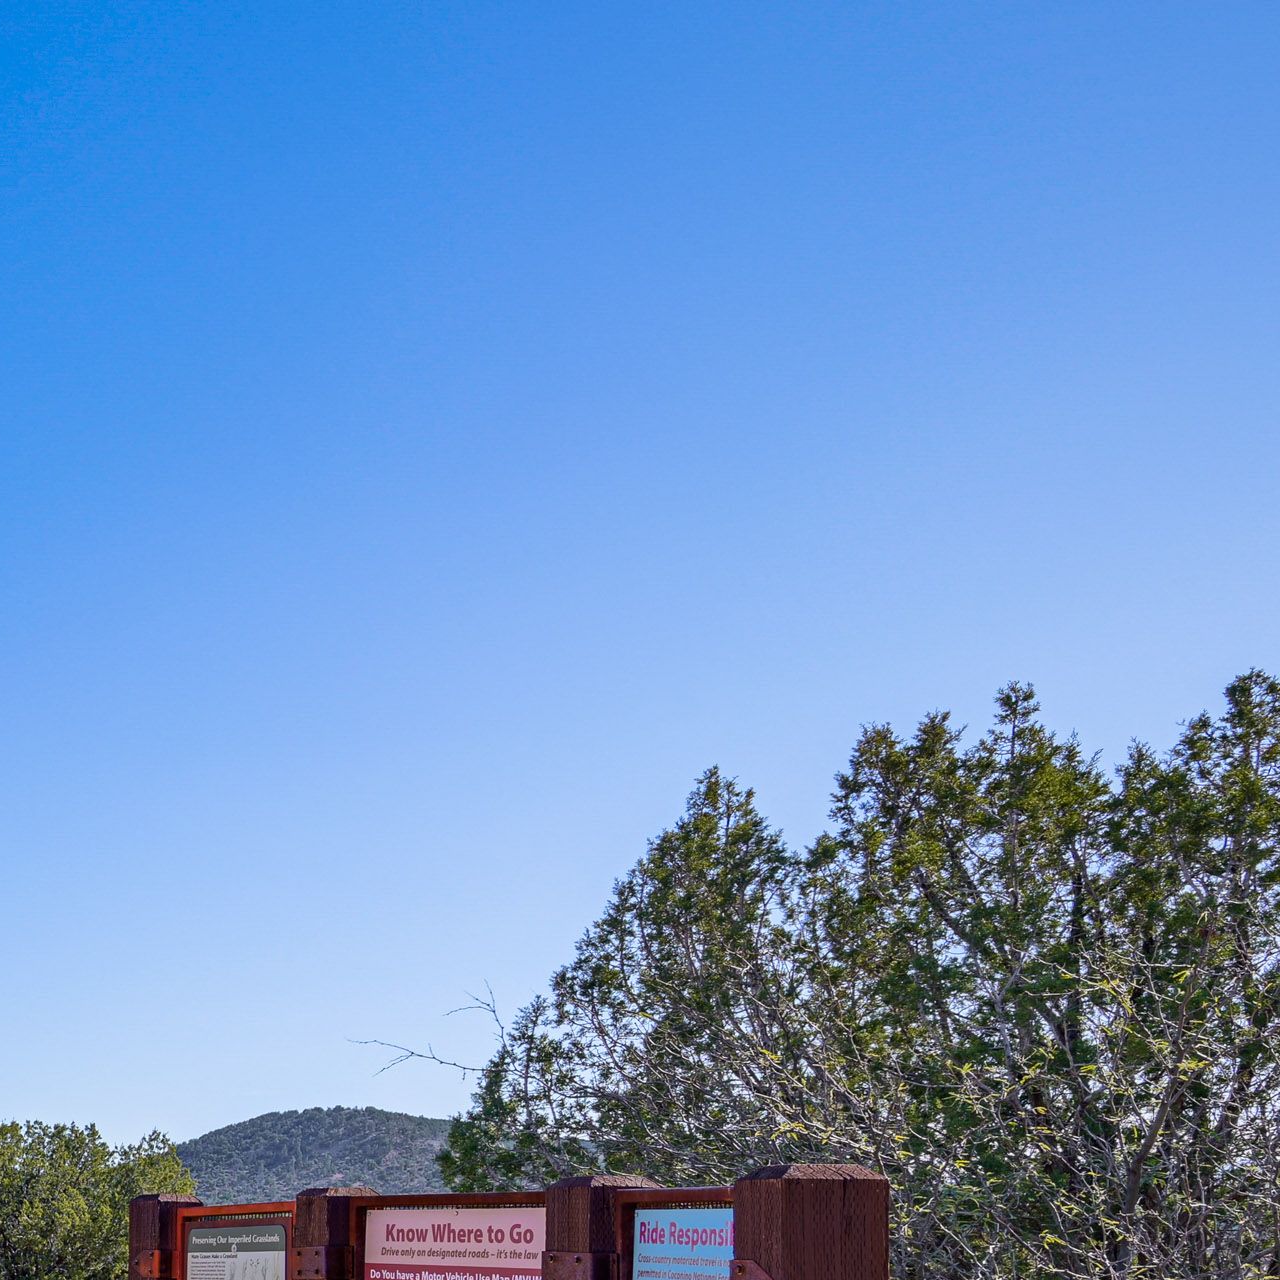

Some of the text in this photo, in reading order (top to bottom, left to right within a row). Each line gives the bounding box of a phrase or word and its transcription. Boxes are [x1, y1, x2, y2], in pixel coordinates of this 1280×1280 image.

[386, 1223, 534, 1244] Know Where to Go
[640, 1221, 665, 1244] Ride
[192, 1234, 280, 1246] Preserving Our Imperiled Grasslands
[381, 1247, 399, 1256] Drive
[400, 1248, 416, 1258] only
[417, 1249, 426, 1257] on
[427, 1248, 467, 1259] designated
[468, 1248, 489, 1258] roads
[509, 1249, 522, 1259] the
[523, 1249, 538, 1260] law
[638, 1253, 671, 1266] Cross-country
[370, 1269, 380, 1279] Do
[382, 1269, 395, 1279] You
[396, 1270, 414, 1280] have
[415, 1273, 420, 1280] a
